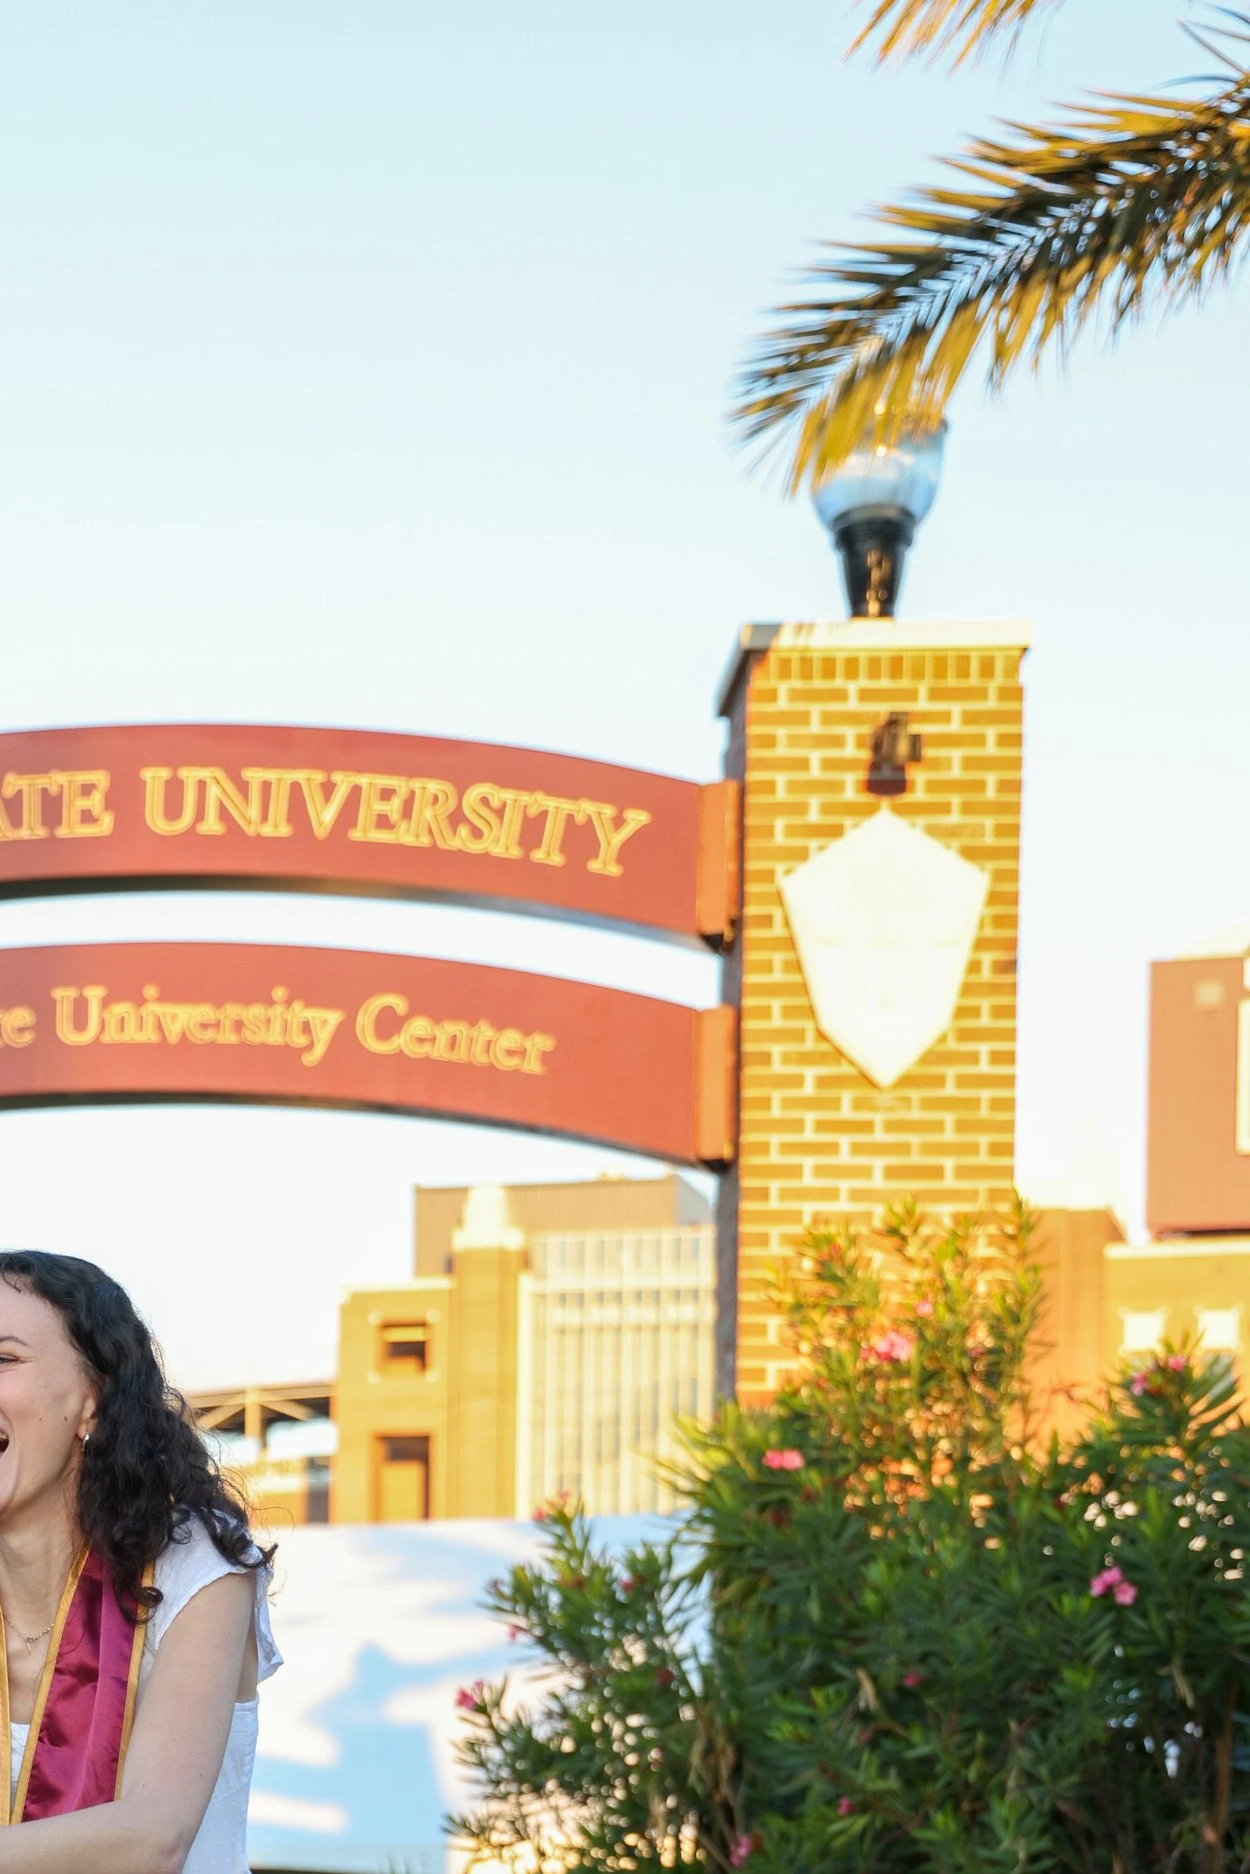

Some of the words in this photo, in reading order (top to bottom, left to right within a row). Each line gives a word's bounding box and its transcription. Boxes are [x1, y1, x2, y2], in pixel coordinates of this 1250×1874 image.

[140, 766, 651, 877] UNIVERSITY
[51, 985, 345, 1067] University
[355, 994, 555, 1075] Center
